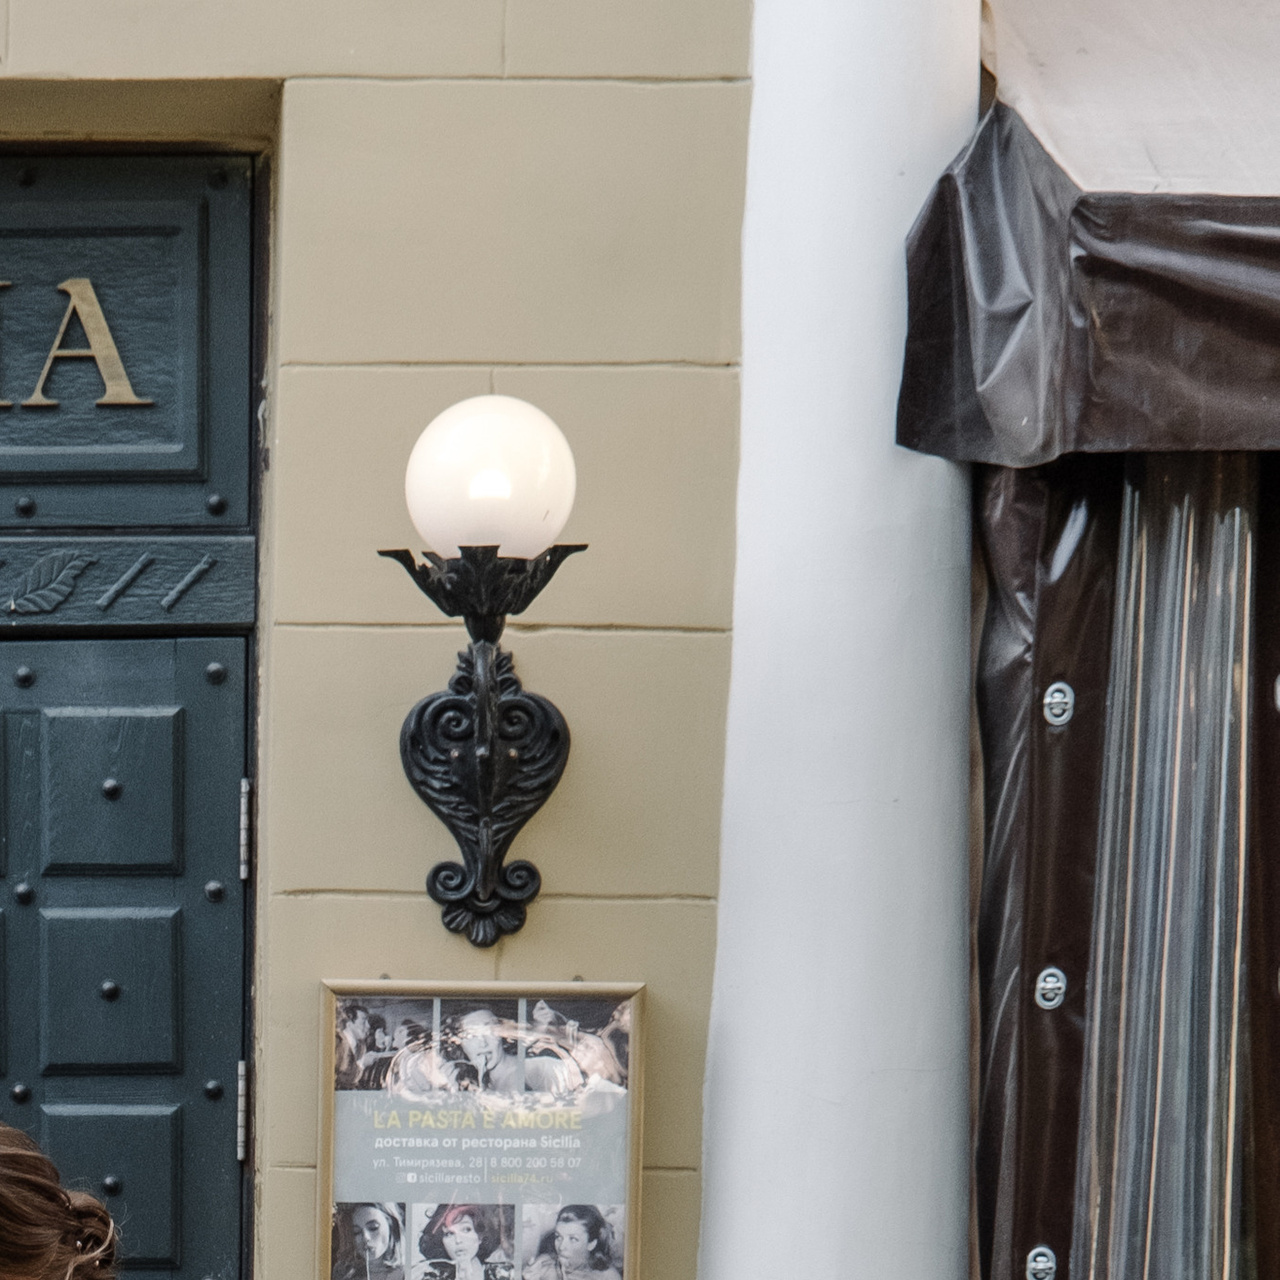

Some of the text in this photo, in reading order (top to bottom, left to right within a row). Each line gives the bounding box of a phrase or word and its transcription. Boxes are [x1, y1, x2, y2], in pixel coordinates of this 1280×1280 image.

[373, 1110, 401, 1129] LA
[408, 1110, 476, 1129] PASTA
[501, 1110, 582, 1129] AMORE
[375, 1135, 581, 1151] доставка от ресторана Sicilia
[372, 1156, 483, 1170] ул. Тимирязева, 28
[490, 1157, 497, 1168] 8
[500, 1157, 522, 1168] 800
[526, 1157, 547, 1168] 200
[567, 1157, 581, 1168] 07
